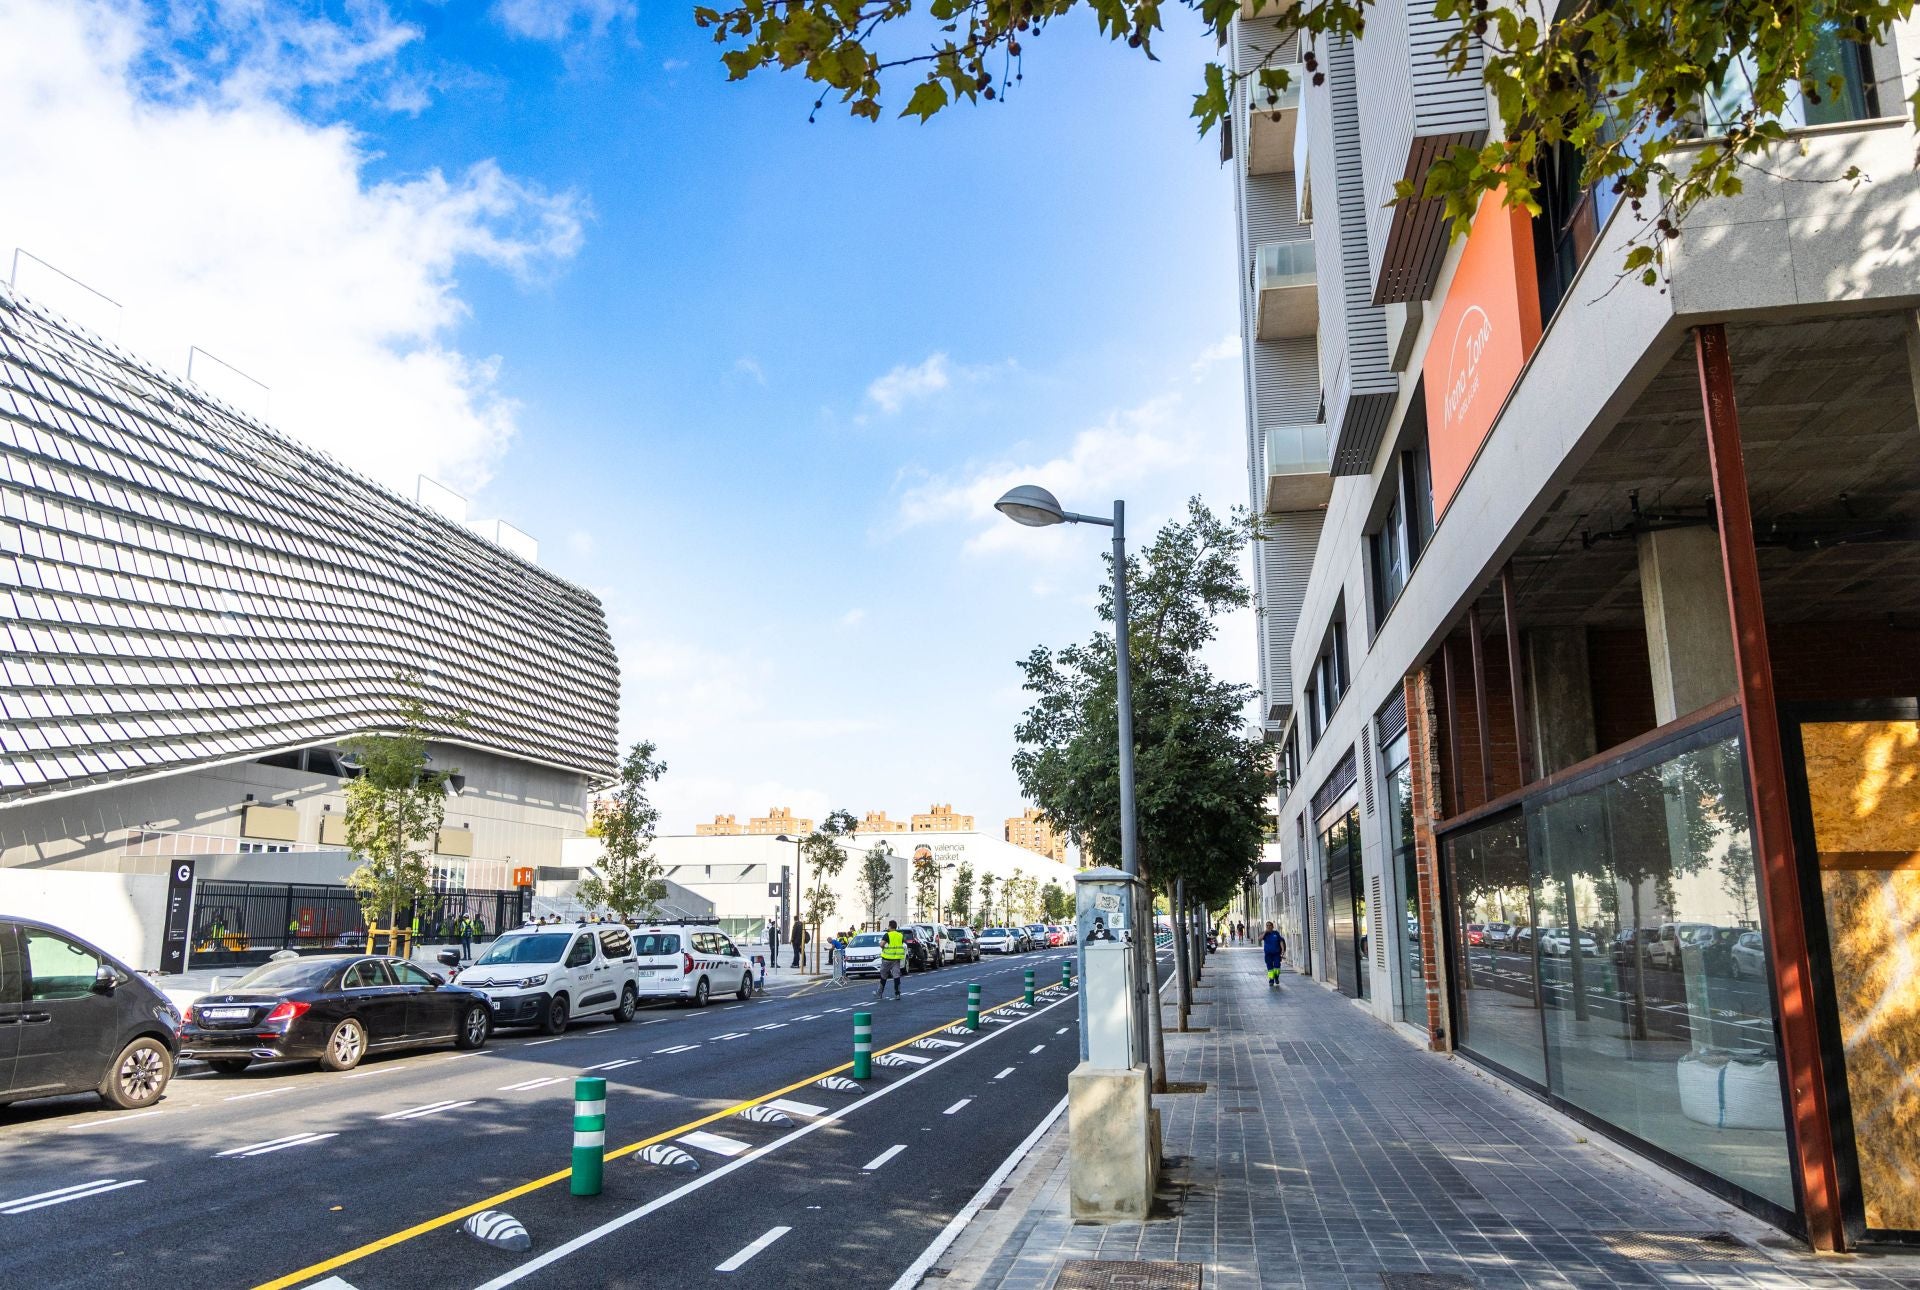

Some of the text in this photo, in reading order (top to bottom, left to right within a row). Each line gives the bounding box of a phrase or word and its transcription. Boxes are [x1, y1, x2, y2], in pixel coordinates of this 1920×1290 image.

[1466, 318, 1491, 378] Zone
[934, 843, 965, 851] valencia
[934, 853, 959, 861] basket
[178, 865, 190, 882] G
[525, 870, 531, 882] H
[772, 885, 779, 895] J
